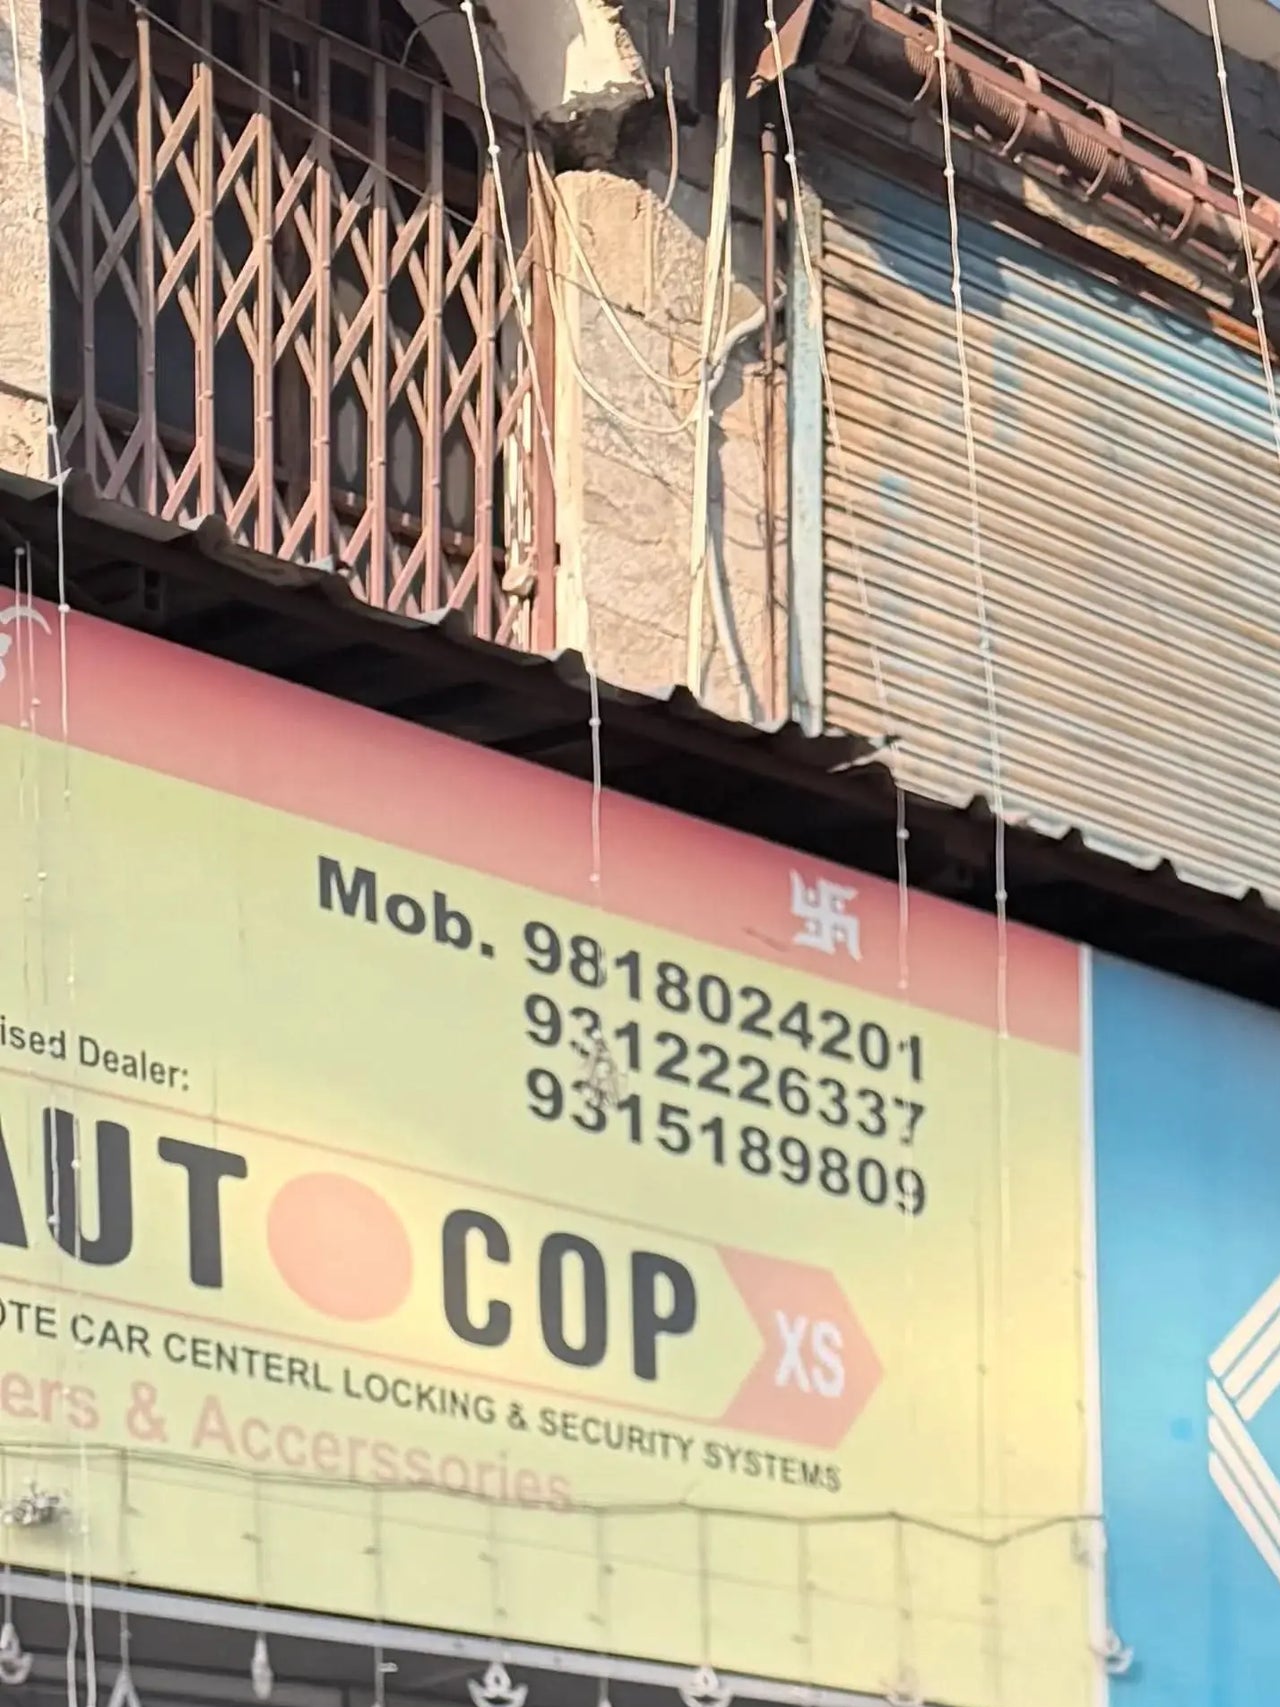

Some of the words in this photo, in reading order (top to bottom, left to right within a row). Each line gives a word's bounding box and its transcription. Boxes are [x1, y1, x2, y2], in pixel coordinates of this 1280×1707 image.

[318, 855, 495, 960] Mob.
[523, 921, 923, 1082] 9818024201
[78, 1036, 190, 1091] Dealer:
[524, 993, 925, 1146] 9312226337
[526, 1067, 926, 1217] 9315189809
[441, 1208, 697, 1381] COP
[774, 1309, 846, 1398] XS
[70, 1313, 152, 1357] CAR
[163, 1332, 335, 1394] CENTERL
[344, 1368, 496, 1424] LOCKING
[506, 1401, 528, 1432] &
[539, 1407, 696, 1465] SECURITY
[704, 1442, 843, 1493] SYSTEMS
[125, 1379, 168, 1445] &
